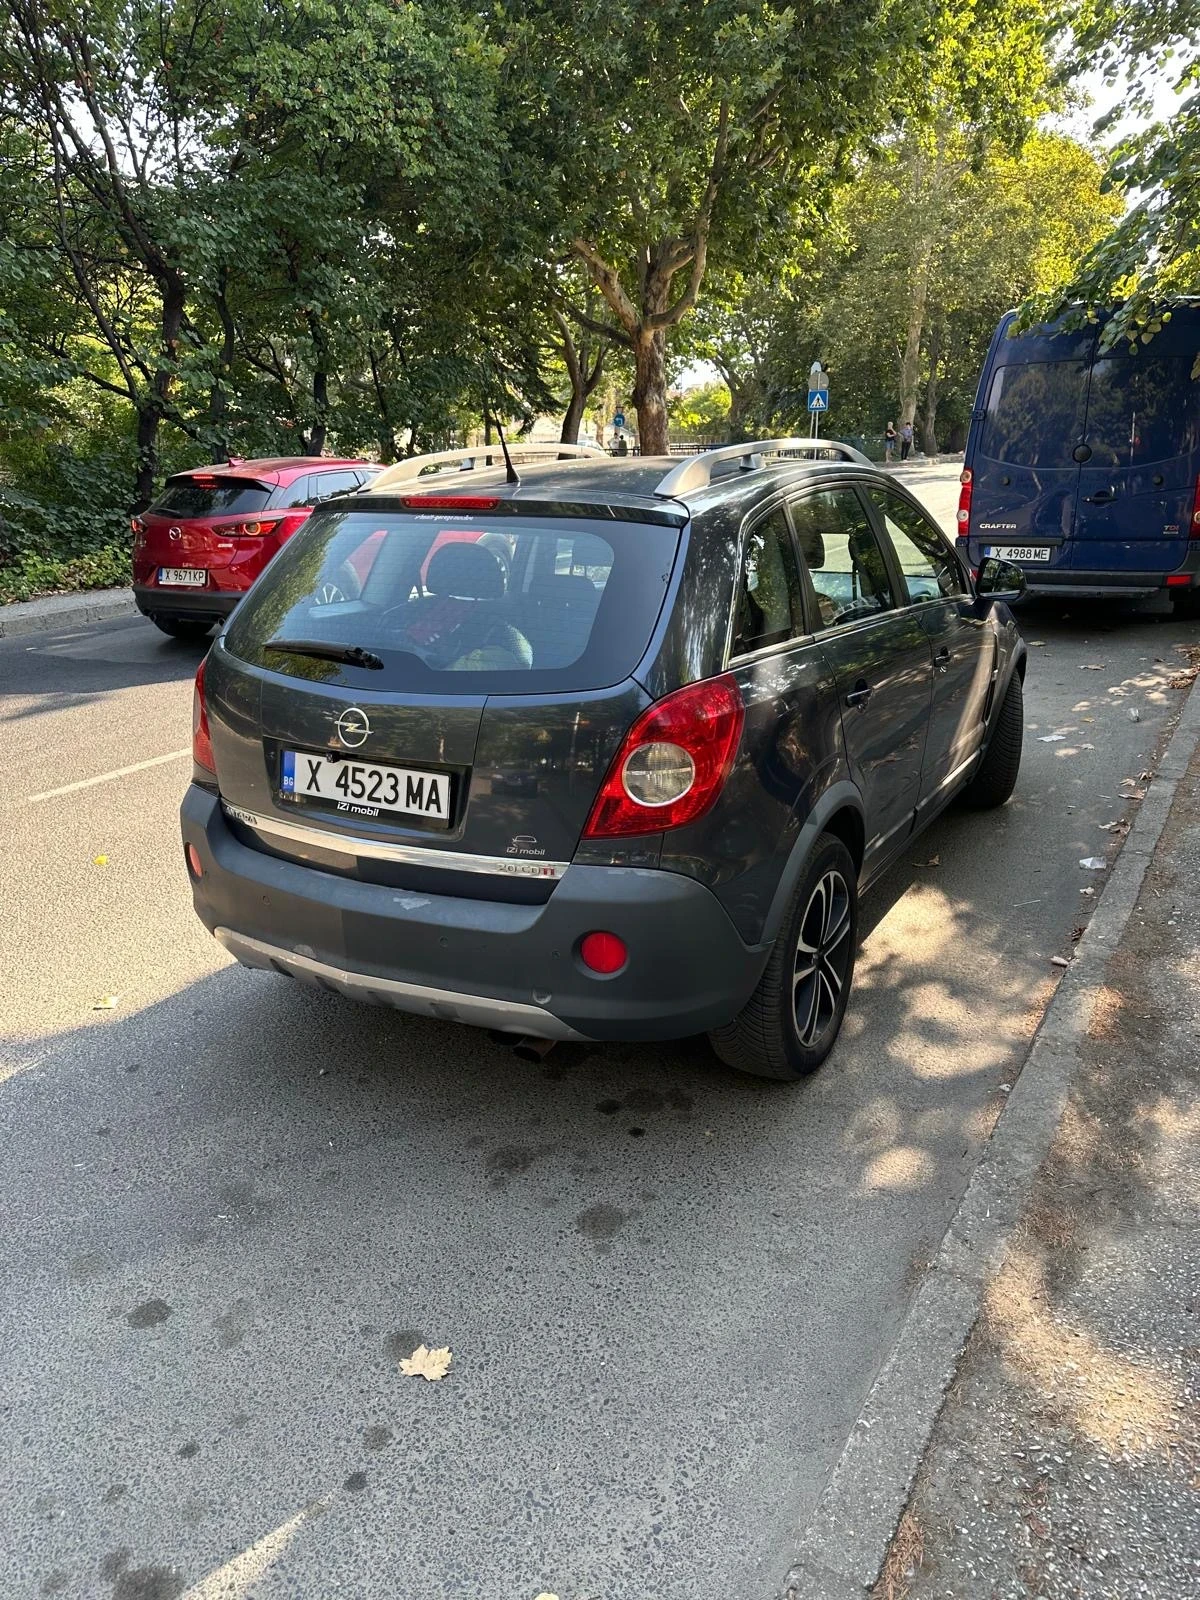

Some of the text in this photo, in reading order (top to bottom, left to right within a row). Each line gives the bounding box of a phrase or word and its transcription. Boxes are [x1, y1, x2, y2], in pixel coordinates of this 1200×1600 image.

[995, 547, 1002, 558] X
[165, 569, 171, 580] X
[283, 776, 294, 786] BG
[306, 759, 442, 813] X 4523 MA
[336, 801, 380, 817] iZi mobil
[519, 848, 546, 856] mobil
